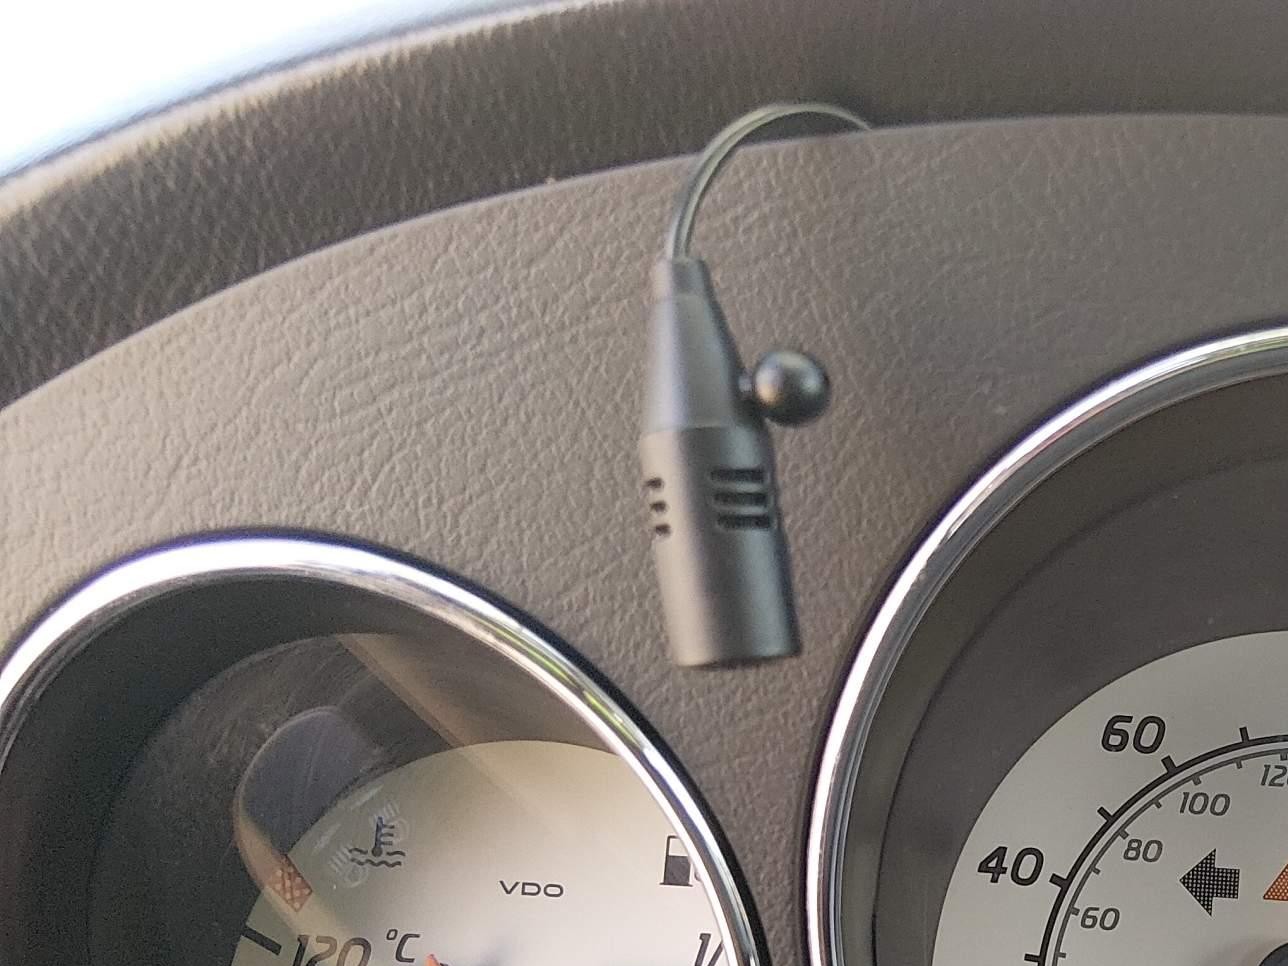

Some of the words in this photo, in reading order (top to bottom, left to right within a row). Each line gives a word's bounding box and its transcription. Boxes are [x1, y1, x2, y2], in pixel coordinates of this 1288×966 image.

[1101, 715, 1166, 754] 60
[1179, 791, 1231, 816] 100
[1123, 838, 1163, 863] 80
[977, 846, 1044, 886] 40
[499, 880, 564, 898] VDO
[1080, 906, 1120, 930] 60
